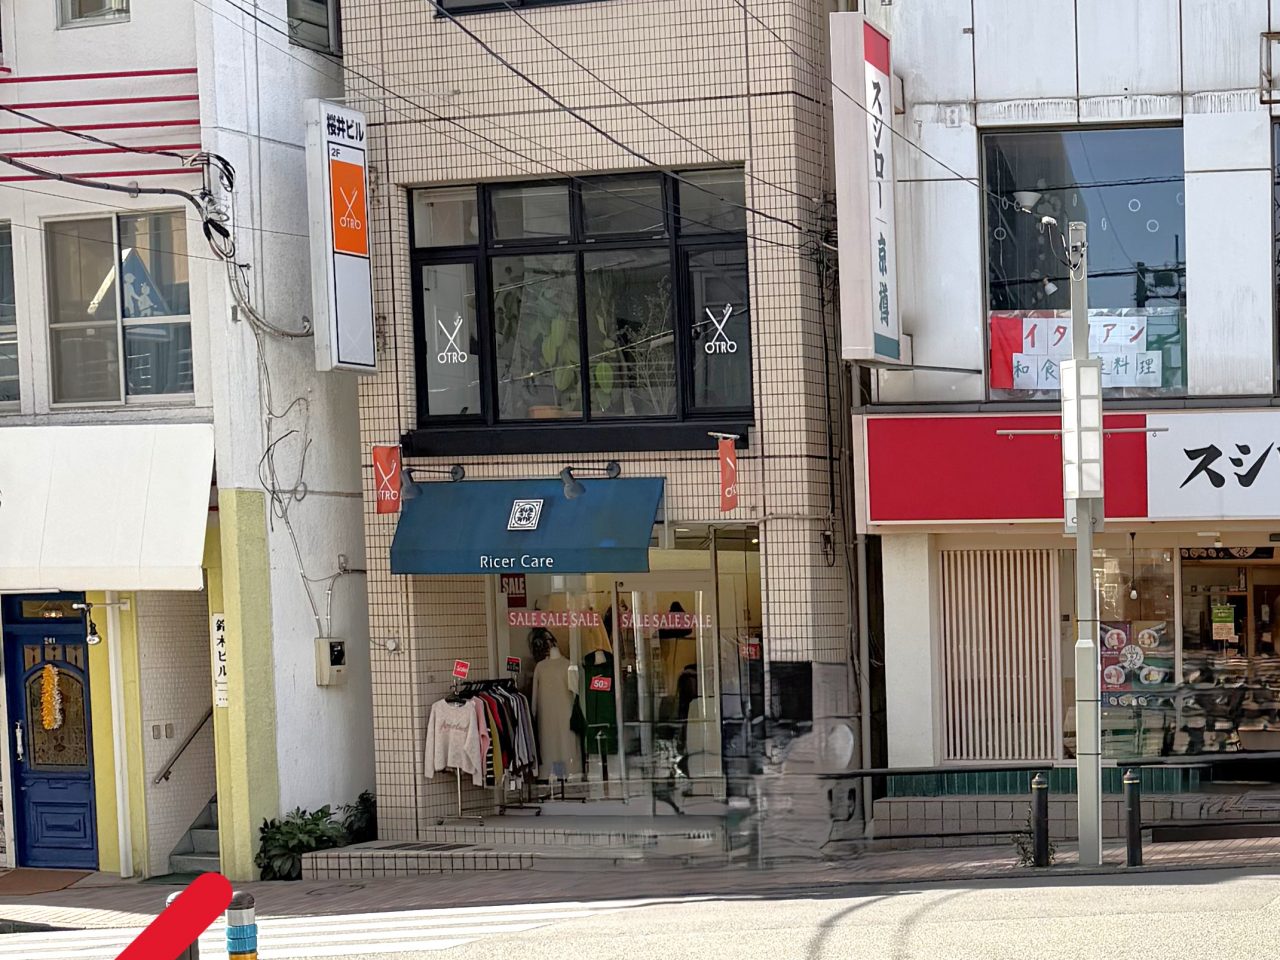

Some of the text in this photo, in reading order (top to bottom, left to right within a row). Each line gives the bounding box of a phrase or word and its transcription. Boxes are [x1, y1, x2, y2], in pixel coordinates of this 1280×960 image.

[326, 112, 364, 142] 桜井ビル
[871, 79, 885, 209] スシロー
[331, 147, 341, 158] 2F
[340, 216, 362, 230] OTRO
[1023, 323, 1145, 348] イタアン
[704, 340, 737, 354] OTRO
[437, 351, 468, 364] OTRO
[1014, 355, 1156, 382] 和食料理
[480, 555, 554, 568] Ricer Care
[501, 576, 525, 594] SALE
[509, 612, 599, 627] SALE SALE SALE
[622, 613, 713, 629] SALE SALE SALE
